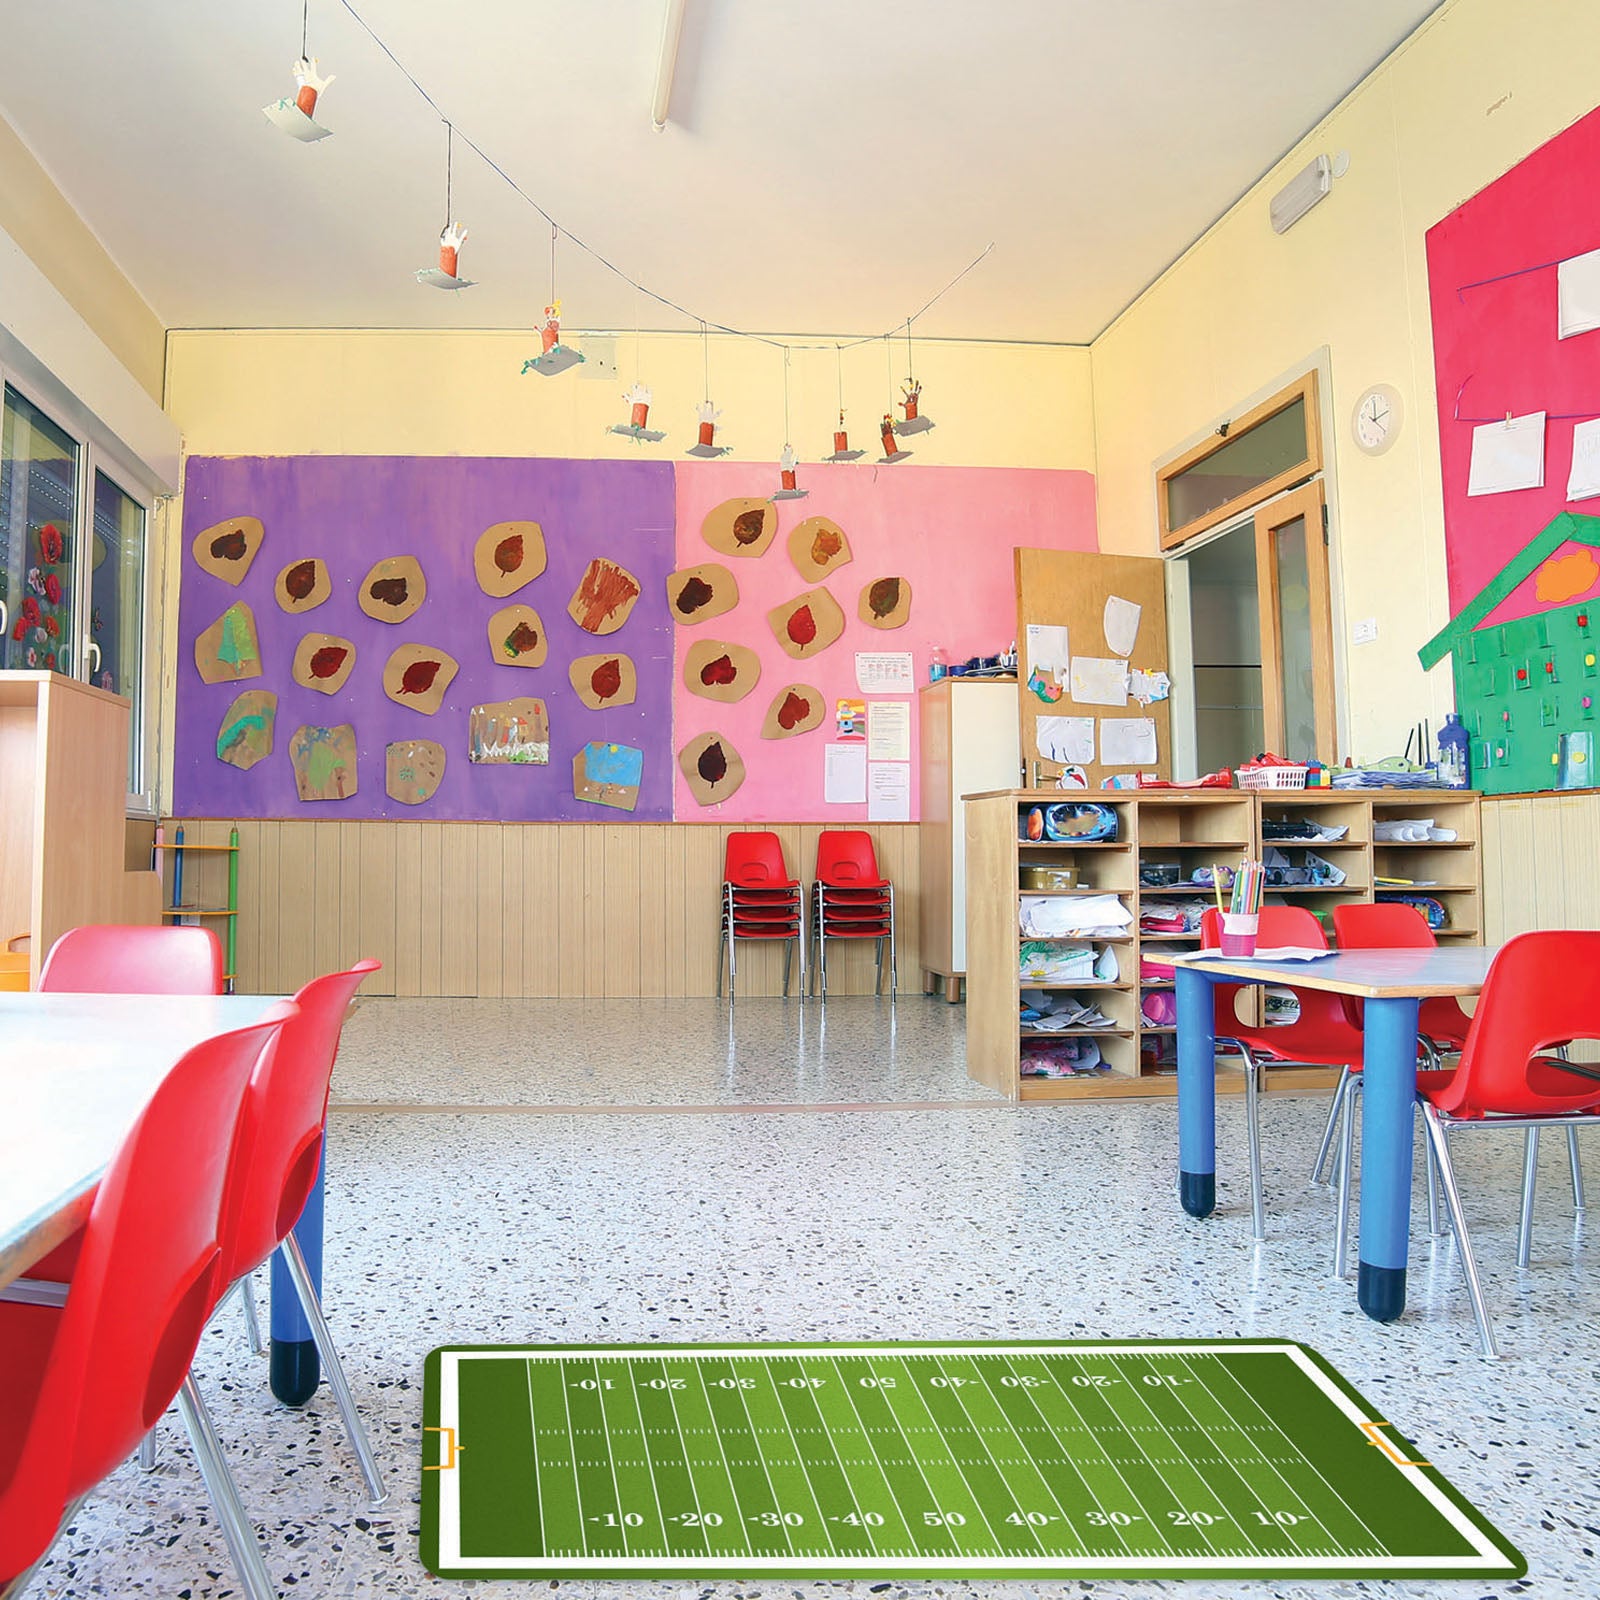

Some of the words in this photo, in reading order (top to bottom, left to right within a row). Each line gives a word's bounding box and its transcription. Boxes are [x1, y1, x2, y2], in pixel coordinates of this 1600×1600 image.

[580, 1378, 616, 1391] 10
[650, 1378, 687, 1391] 20
[719, 1378, 757, 1390] 30
[789, 1377, 826, 1389] 40
[860, 1377, 896, 1389] 50
[930, 1376, 971, 1388] 40
[1000, 1375, 1041, 1388] 30
[1071, 1375, 1112, 1387] 20
[1142, 1374, 1184, 1387] 10
[603, 1512, 644, 1527] 10
[681, 1512, 723, 1527] 20
[761, 1512, 804, 1527] 30
[841, 1512, 884, 1527] 40
[922, 1511, 966, 1527] 50
[1005, 1511, 1048, 1527] 40
[1085, 1511, 1133, 1527] 30
[1167, 1511, 1214, 1527] 20
[1250, 1511, 1297, 1526] 10
